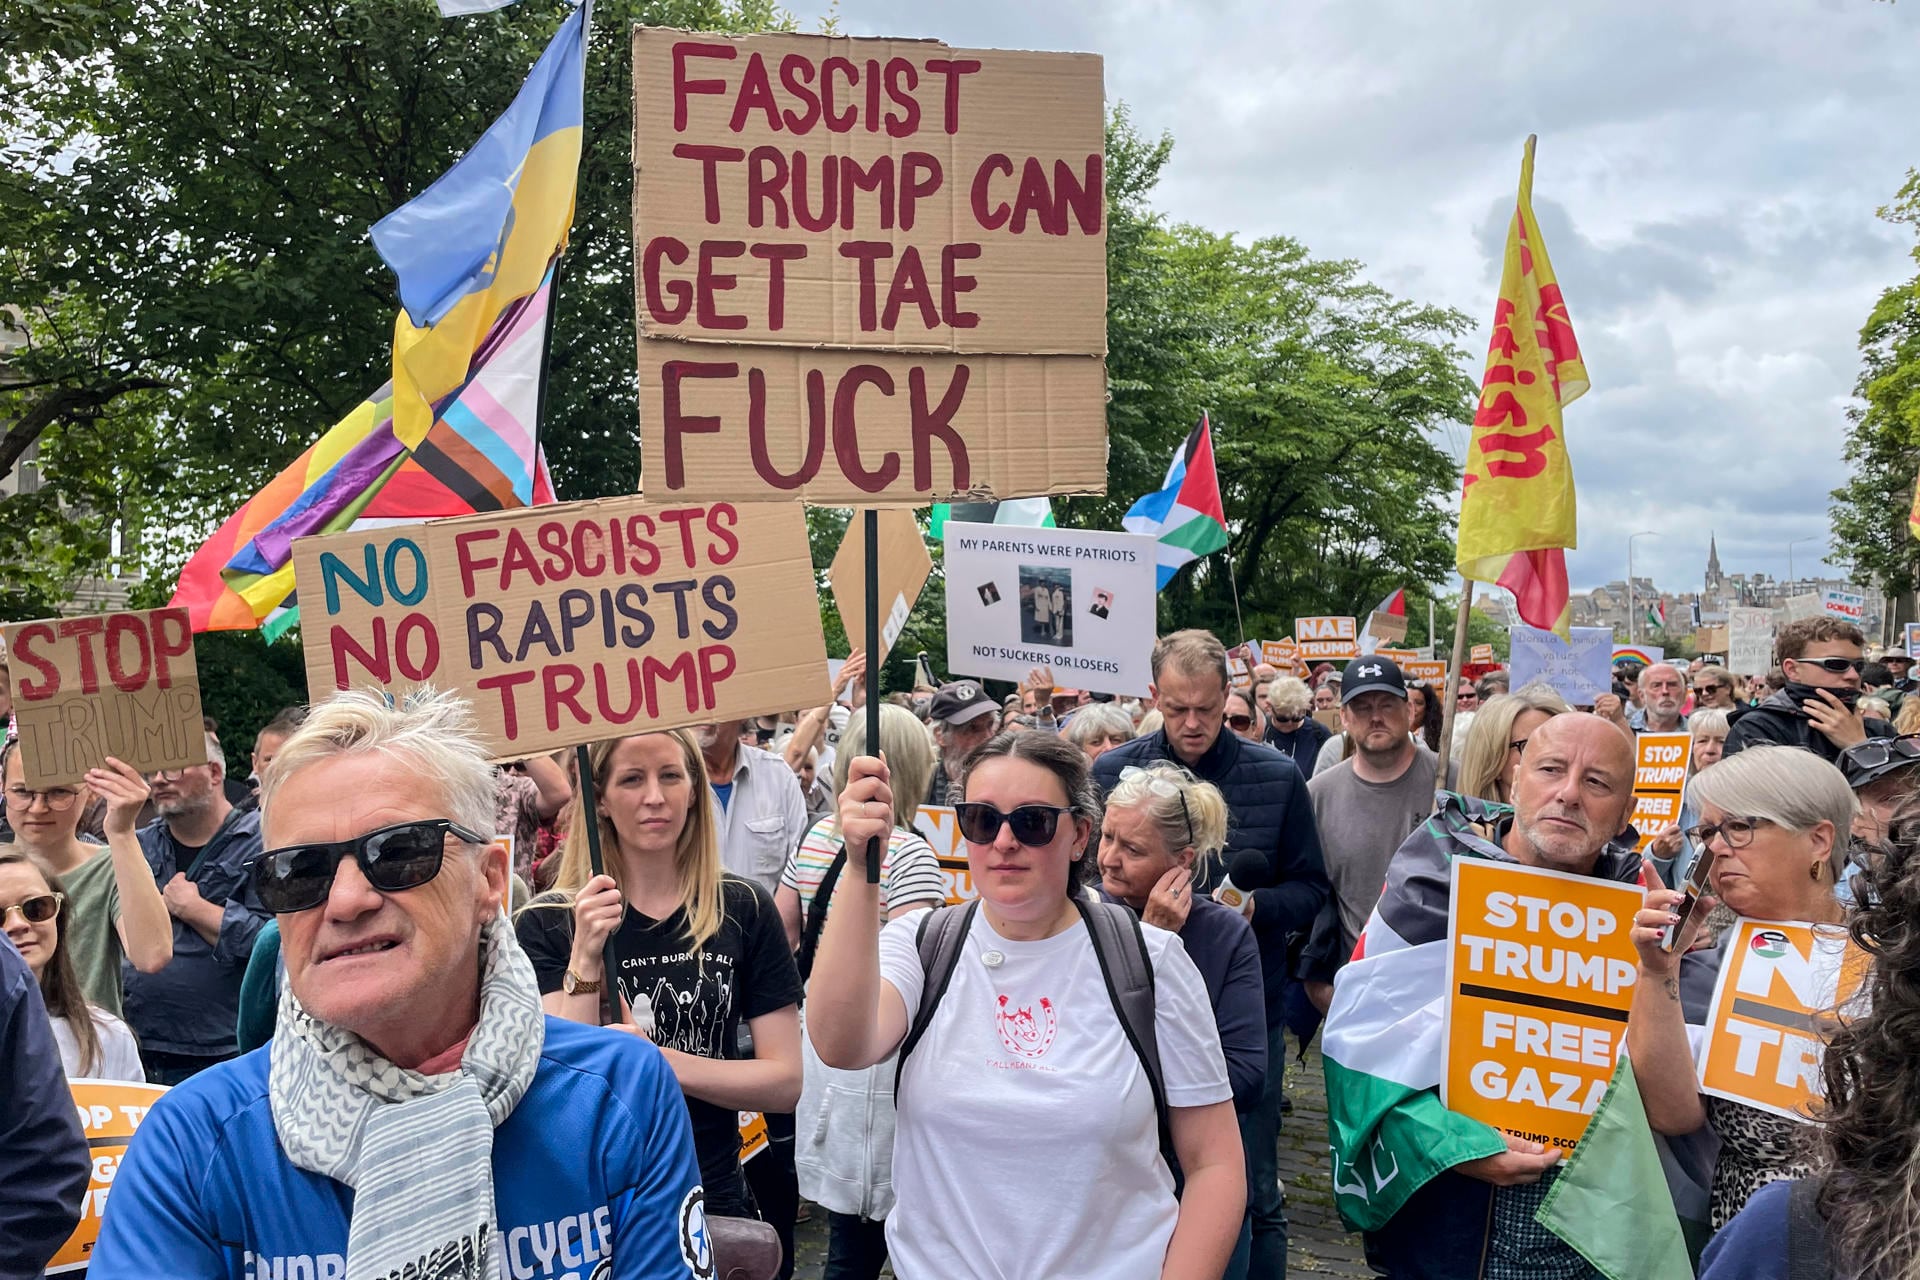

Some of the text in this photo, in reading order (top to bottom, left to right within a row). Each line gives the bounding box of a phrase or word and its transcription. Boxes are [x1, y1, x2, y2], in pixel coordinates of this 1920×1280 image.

[672, 42, 981, 137] FASCIST
[672, 143, 1103, 236] TRUMP CAN
[643, 236, 982, 331] GET TAE
[662, 360, 970, 493] FUCK
[321, 502, 740, 615] NO FASCISTS
[960, 538, 1137, 562] MY PARENTS WERE PATRIOTS
[13, 608, 192, 701] STOP
[330, 574, 738, 691] NO RAPISTS
[973, 644, 1119, 674] NOT SUCKERS OR LOSERS
[1300, 620, 1353, 639] NAE
[1301, 642, 1354, 655] TRUMP
[477, 644, 737, 741] TRUMP
[16, 684, 201, 777] TRUMP
[1644, 746, 1682, 763] STOP
[1638, 767, 1684, 784] TRUMP
[1636, 798, 1672, 815] FREE
[1483, 891, 1617, 943] STOP
[622, 956, 656, 969] CAN'T
[661, 952, 693, 965] BURN
[716, 953, 734, 967] ALL
[1461, 934, 1637, 995] TRUMP
[1482, 1011, 1611, 1068] FREE
[497, 1205, 612, 1280] ICYCLE
